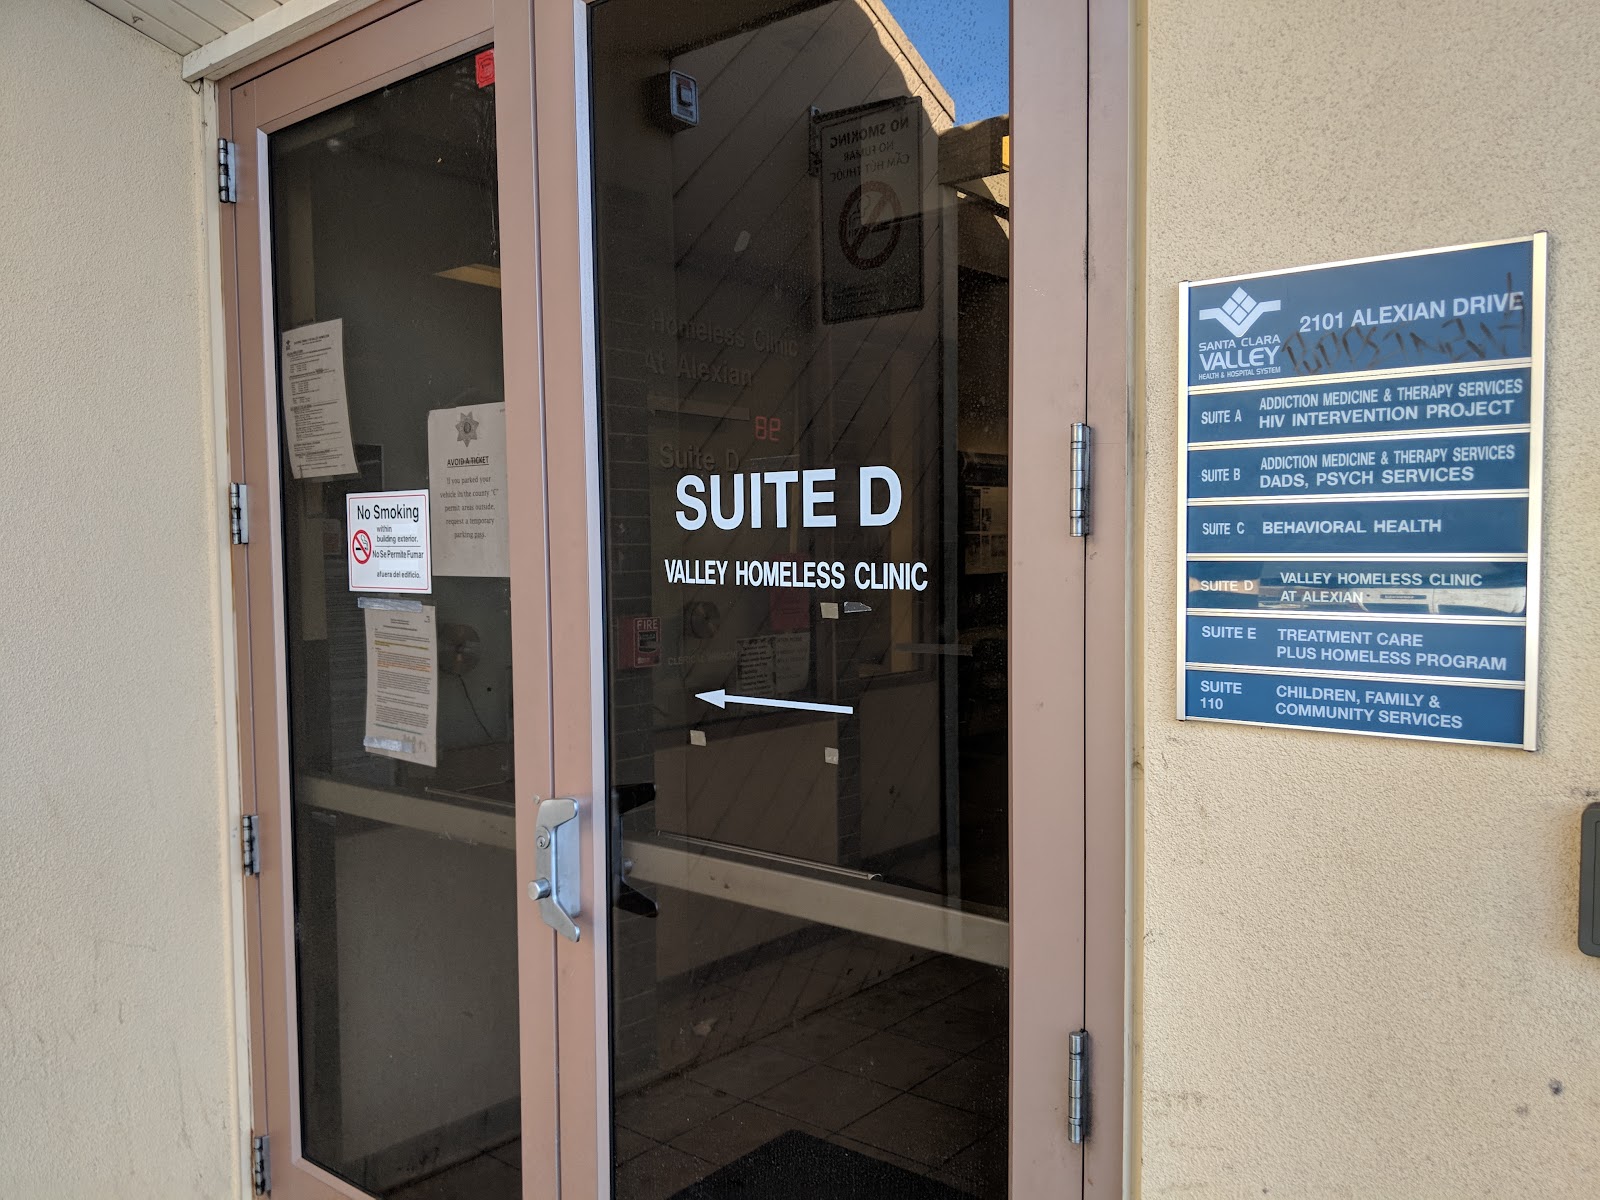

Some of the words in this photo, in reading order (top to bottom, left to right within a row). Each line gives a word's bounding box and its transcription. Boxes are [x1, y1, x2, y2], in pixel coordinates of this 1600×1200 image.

[1300, 311, 1343, 332] 2101
[1351, 300, 1444, 327] ALEXIAN
[1453, 291, 1524, 316] DRIVE
[652, 310, 744, 349] Homeless
[753, 327, 798, 357] Clinic
[1198, 338, 1237, 352] SANTA
[1241, 334, 1280, 346] CLARA
[1199, 345, 1280, 371] VALLEY
[677, 353, 753, 388] Alexian
[1199, 372, 1220, 380] HEALTH
[1226, 368, 1255, 378] HOSPITAL
[1256, 366, 1281, 376] SYSTEM
[1260, 394, 1319, 411] ADDICTION
[1322, 390, 1378, 406] MEDICINE
[1384, 389, 1391, 402] &
[1397, 384, 1453, 400] THERAPY
[1458, 378, 1523, 396] SERVICES
[1201, 411, 1231, 425] SUITE
[1234, 410, 1242, 422] A
[1259, 414, 1284, 429] HIV
[1292, 407, 1418, 427] INTERVENTION
[1426, 400, 1514, 419] PROJECT
[447, 457, 464, 466] AVOID
[660, 442, 716, 470] Suite
[726, 449, 740, 471] D
[1261, 455, 1318, 471] ADDICTION
[1322, 452, 1376, 467] MEDICINE
[1380, 451, 1388, 464] &
[1393, 448, 1447, 463] THERAPY
[1453, 444, 1515, 462] SERVICES
[461, 476, 479, 485] parked
[480, 476, 491, 485] your
[1201, 469, 1230, 483] SUITE
[1233, 469, 1240, 481] B
[1260, 474, 1310, 490] DADS,
[1316, 470, 1374, 486] PSYCH
[1382, 466, 1474, 484] SERVICES
[473, 490, 490, 498] county
[676, 468, 837, 531] SUITE
[859, 465, 902, 526] D
[357, 504, 370, 520] No
[373, 504, 419, 523] Smoking
[444, 504, 460, 512] permit
[469, 517, 495, 525] temporary
[1202, 523, 1230, 535] SUITE
[1237, 522, 1245, 534] C
[1262, 520, 1366, 534] BEHAVIORAL
[1374, 519, 1442, 533] HEALTH
[376, 525, 392, 533] within
[454, 530, 473, 539] parking
[376, 534, 396, 544] building
[397, 535, 419, 543] exterior.
[372, 550, 380, 558] No
[380, 550, 387, 558] Se
[387, 550, 406, 558] Permite
[407, 550, 424, 558] Fumar
[665, 559, 728, 585] VALLEY
[735, 560, 845, 589] HOMELESS
[854, 561, 928, 591] CLINIC
[1280, 572, 1332, 585] VALLEY
[1338, 573, 1422, 586] HOMELESS
[1429, 573, 1482, 587] CLINIC
[1201, 579, 1238, 592] SUITE
[1244, 580, 1254, 592] D
[1280, 591, 1297, 602] AT
[1302, 590, 1363, 603] ALEXIAN
[637, 619, 658, 630] FIRE
[1202, 626, 1243, 639] SUITE
[1247, 627, 1256, 640] E
[1278, 629, 1372, 645] TREATMENT
[1377, 632, 1423, 647] CARE
[1277, 646, 1316, 660] PLUS
[1321, 648, 1411, 666] HOMELESS
[1416, 653, 1507, 671] PROGRAM
[1201, 681, 1242, 695] SUITE
[1201, 698, 1223, 710] 110
[1276, 685, 1361, 705] CHILDREN,
[1365, 691, 1424, 707] FAMILY
[1429, 695, 1440, 708] &
[1276, 703, 1374, 722] COMMUNITY
[1378, 710, 1462, 729] SERVICES
